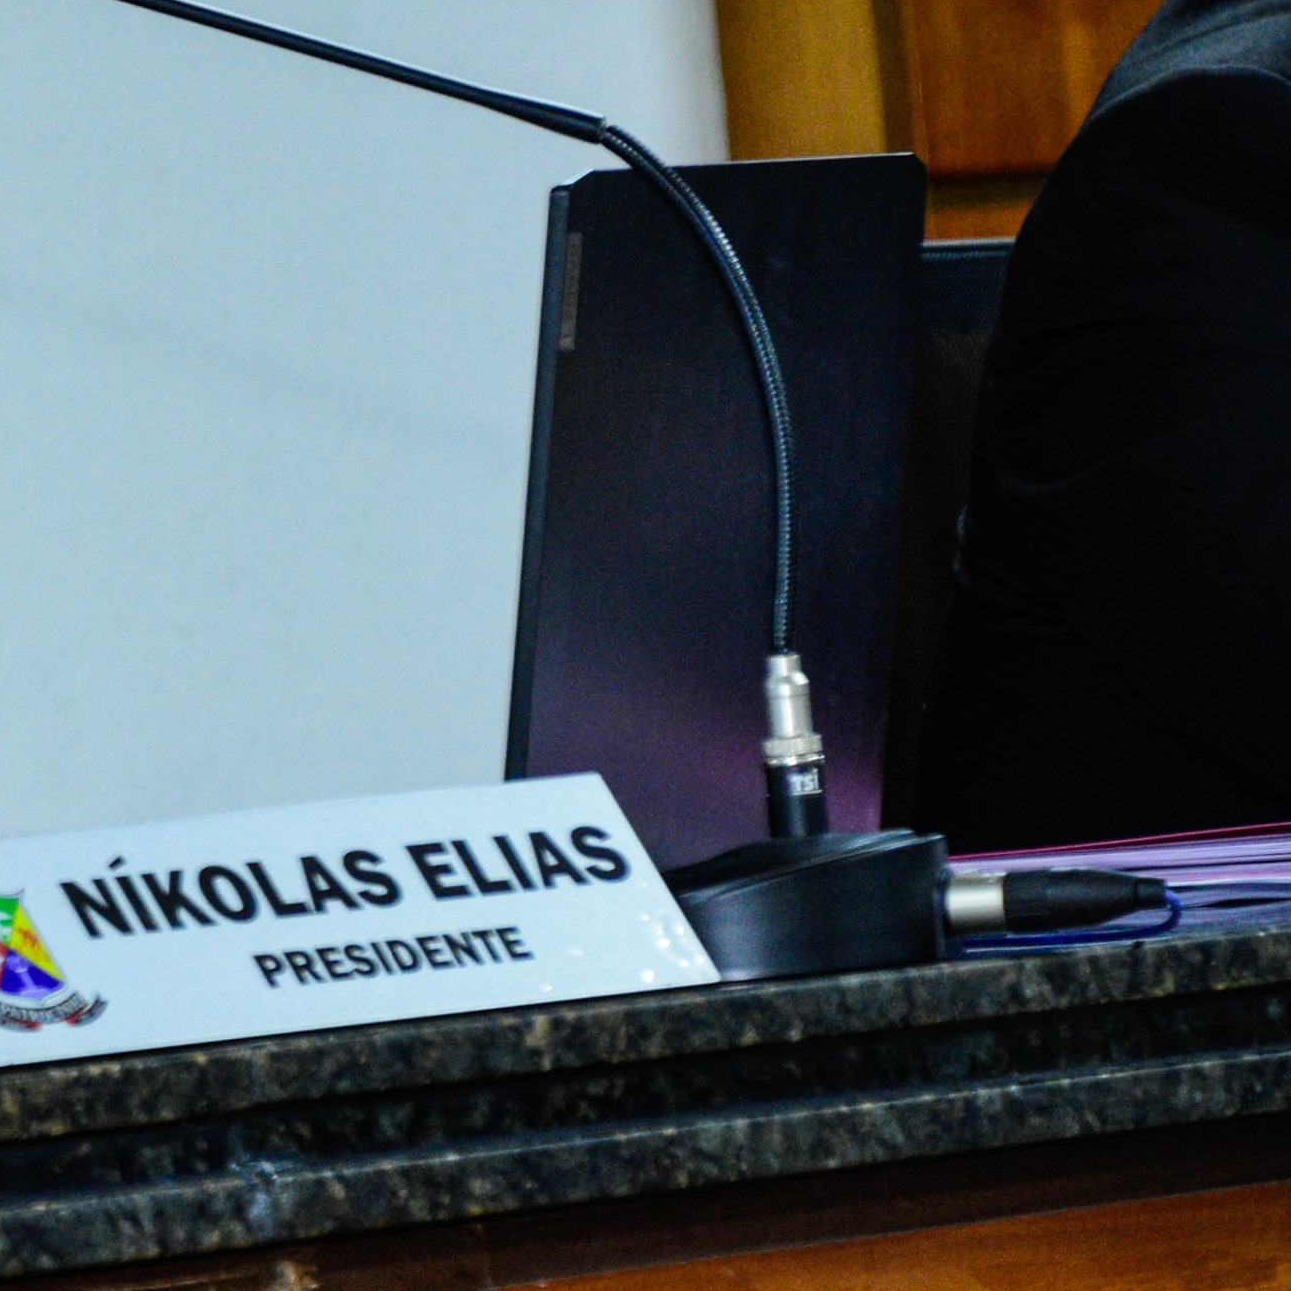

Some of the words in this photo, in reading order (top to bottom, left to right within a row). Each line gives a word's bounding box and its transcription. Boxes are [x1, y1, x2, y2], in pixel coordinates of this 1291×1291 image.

[59, 855, 402, 939] NÍKOLAS
[404, 825, 630, 901] ELIAS
[253, 926, 533, 988] PRESIDENTE
